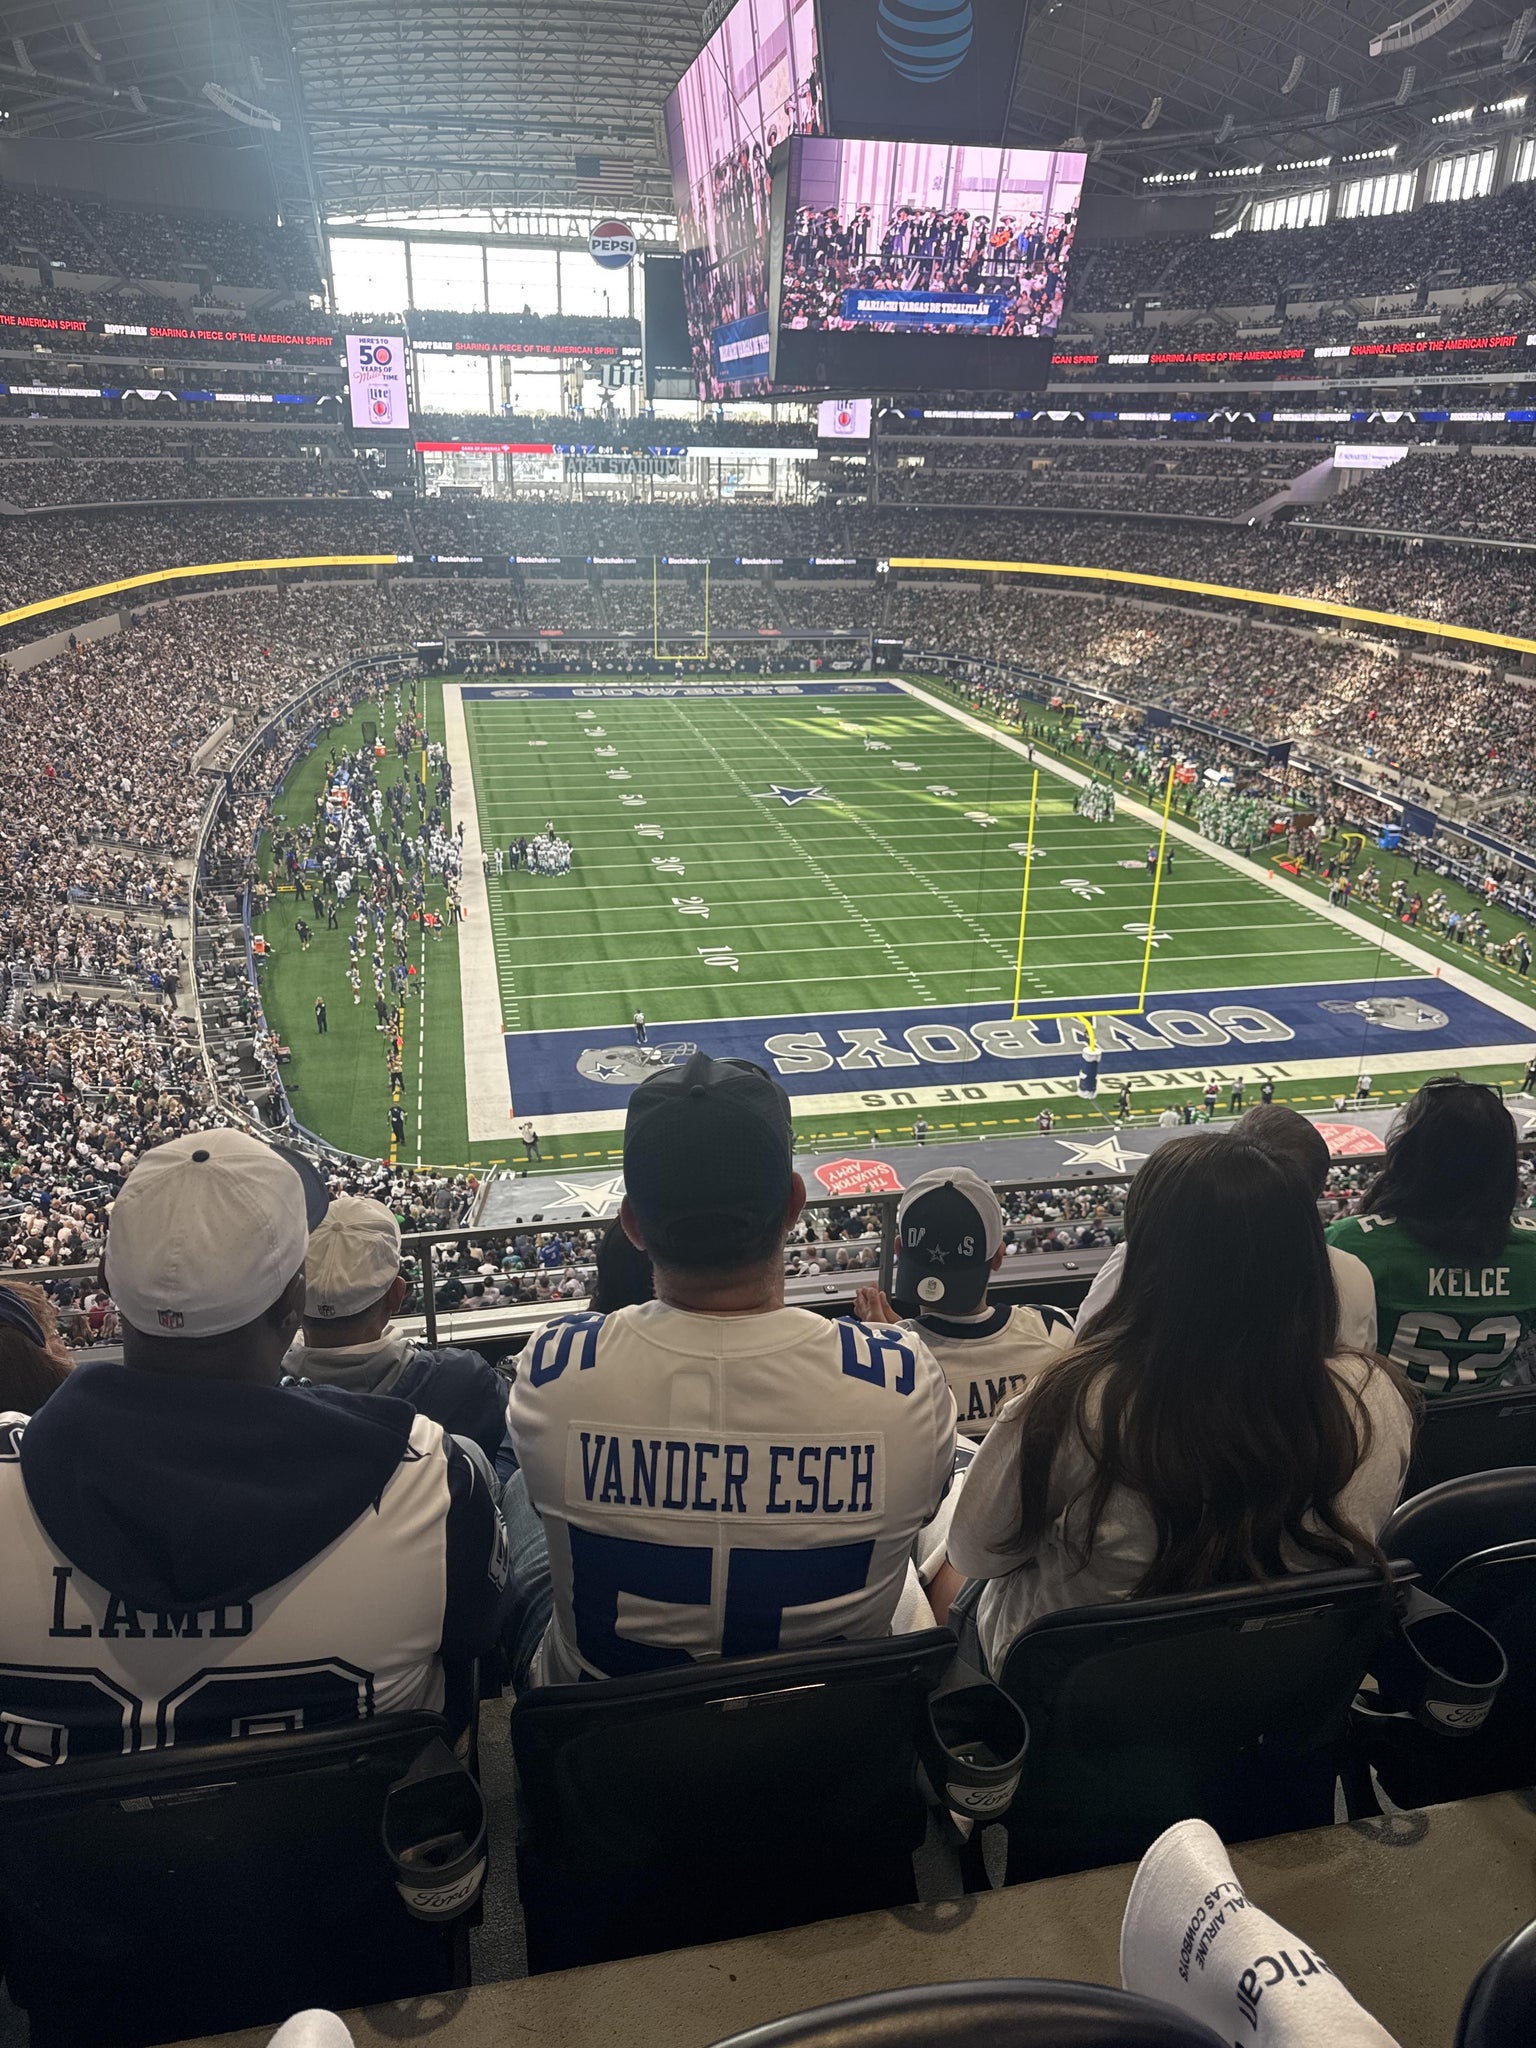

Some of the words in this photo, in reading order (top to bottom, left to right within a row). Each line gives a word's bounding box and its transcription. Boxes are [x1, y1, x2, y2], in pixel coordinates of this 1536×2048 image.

[591, 239, 634, 253] PEPSI
[899, 301, 929, 313] VARGAS
[930, 302, 941, 313] DE
[0, 314, 16, 326] THE
[17, 316, 58, 329] AMERICAN
[60, 320, 87, 332] SPIRIT
[150, 327, 188, 339] SHARING
[189, 330, 196, 339] A
[197, 330, 223, 341] PIECE
[225, 332, 236, 342] OF
[238, 333, 256, 343] THE
[257, 334, 303, 345] AMERICAN
[305, 336, 333, 346] SPIRIT
[359, 337, 379, 345] HERE'S
[455, 342, 490, 352] SHARING
[492, 343, 498, 351] A
[499, 344, 521, 352] PIECE
[523, 344, 533, 353] OF
[536, 345, 551, 353] THE
[552, 345, 593, 355] AMERICAN
[594, 347, 619, 355] SPIRIT
[1351, 344, 1385, 356] SHARING
[1385, 344, 1391, 354] A
[1392, 342, 1415, 353] PIECE
[1416, 342, 1428, 351] OF
[1429, 341, 1445, 351] THE
[1445, 338, 1489, 350] AMERICAN
[1490, 336, 1518, 347] SPIRIT
[359, 345, 392, 366] 50
[1073, 355, 1099, 364] SPIRIT
[1150, 354, 1184, 363] SHARING
[1185, 354, 1192, 362] A
[1193, 353, 1216, 362] PIECE
[1217, 353, 1227, 361] OF
[1228, 352, 1243, 361] THE
[1243, 350, 1282, 360] AMERICAN
[1283, 348, 1305, 359] SPIRIT
[370, 388, 388, 400] Lite
[567, 457, 605, 473] AT&T
[609, 457, 679, 475] STADIUM
[437, 555, 483, 563] Blockchain.com
[516, 556, 560, 564] Blockchain.com
[593, 556, 637, 564] Blockchain.com
[668, 557, 711, 565] Blockchain.com
[742, 557, 783, 565] Blockchain.com
[815, 557, 856, 565] Blockchain.com
[651, 856, 686, 872] 30
[671, 895, 710, 915] 20
[697, 945, 739, 967] 10
[764, 1005, 1296, 1075] COWBOYS
[1106, 1067, 1236, 1090] TAKES
[1255, 1064, 1292, 1079] IT
[862, 1091, 921, 1107] US
[937, 1086, 987, 1103] OF
[829, 1161, 861, 1182] ARMY
[832, 1164, 890, 1190] SALVATION
[1428, 1267, 1510, 1297] KELCE
[1388, 1311, 1522, 1393] 62
[580, 1432, 749, 1513] VANDER
[765, 1444, 875, 1514] ESCH
[412, 1877, 474, 1907] Ford
[1178, 1907, 1206, 1982] COWBOYS
[1195, 1912, 1226, 1970] AIRLINE
